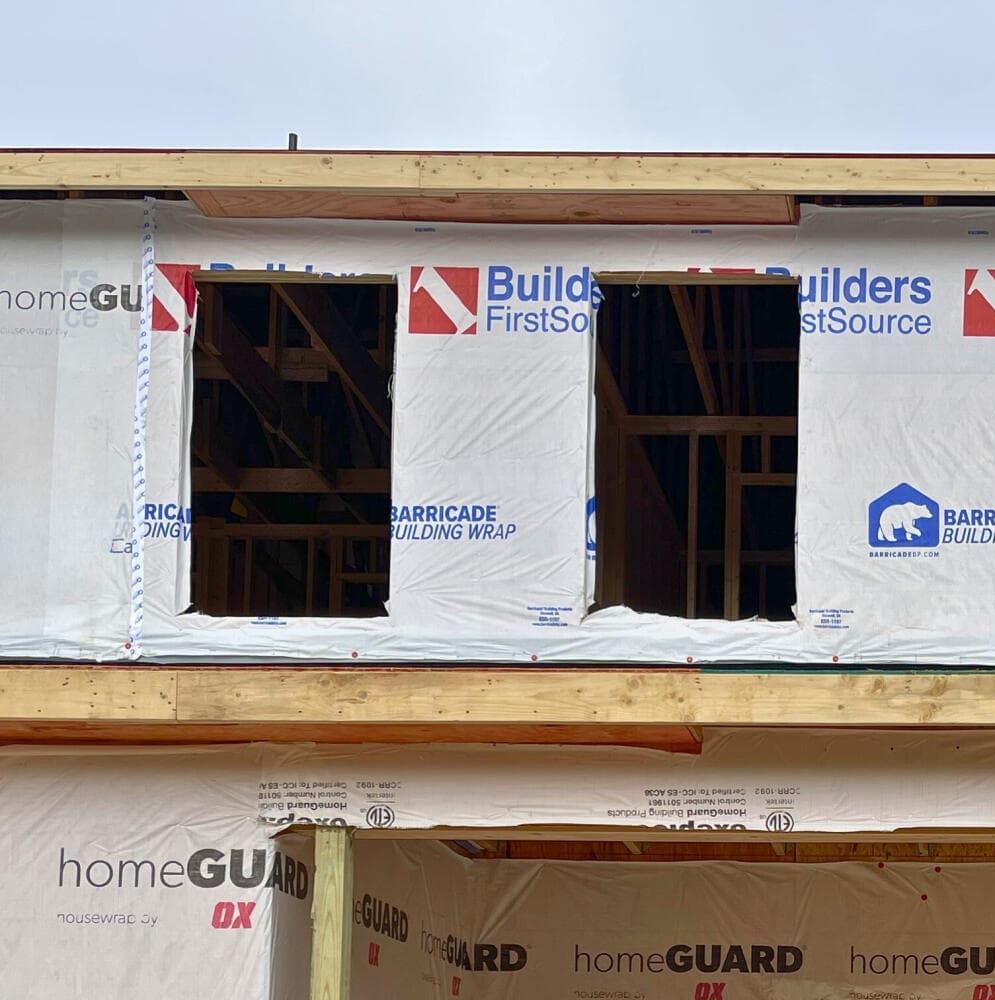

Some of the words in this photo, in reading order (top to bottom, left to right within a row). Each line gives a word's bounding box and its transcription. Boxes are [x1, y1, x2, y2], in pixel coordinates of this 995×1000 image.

[798, 267, 932, 304] uilders
[469, 523, 517, 540] WRAP
[608, 808, 647, 818] Products
[687, 808, 746, 817] HomeGuard
[58, 847, 308, 900] homeGUARD
[211, 901, 257, 929] OX
[574, 943, 804, 974] homeGUARD
